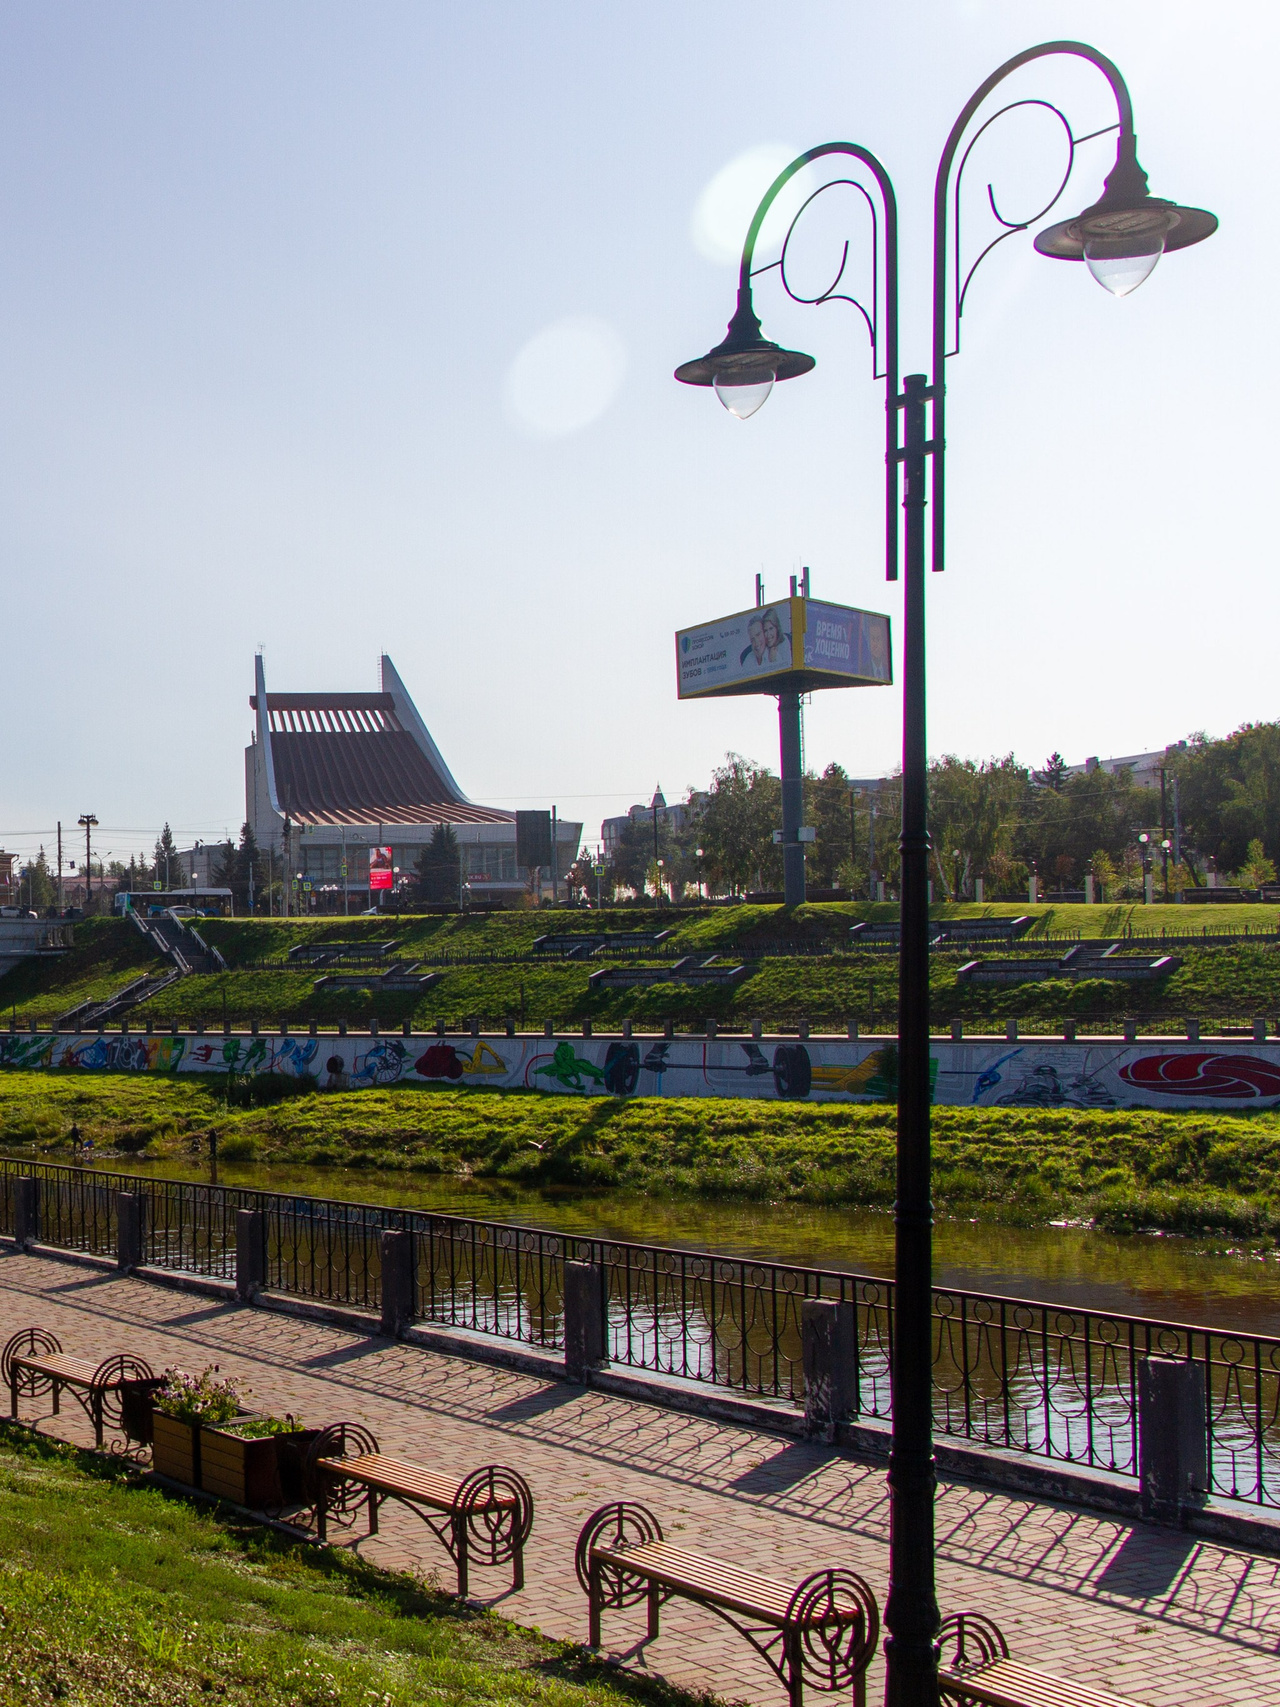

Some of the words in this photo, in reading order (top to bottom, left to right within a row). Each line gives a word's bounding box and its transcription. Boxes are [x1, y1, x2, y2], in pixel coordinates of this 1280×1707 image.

[816, 620, 842, 640] ВРЕМЯ
[815, 638, 850, 659] ХОЦЕНКО
[682, 650, 727, 668] ИМПЛАНТАЦИЯ
[682, 668, 702, 680] ЗУБОВ
